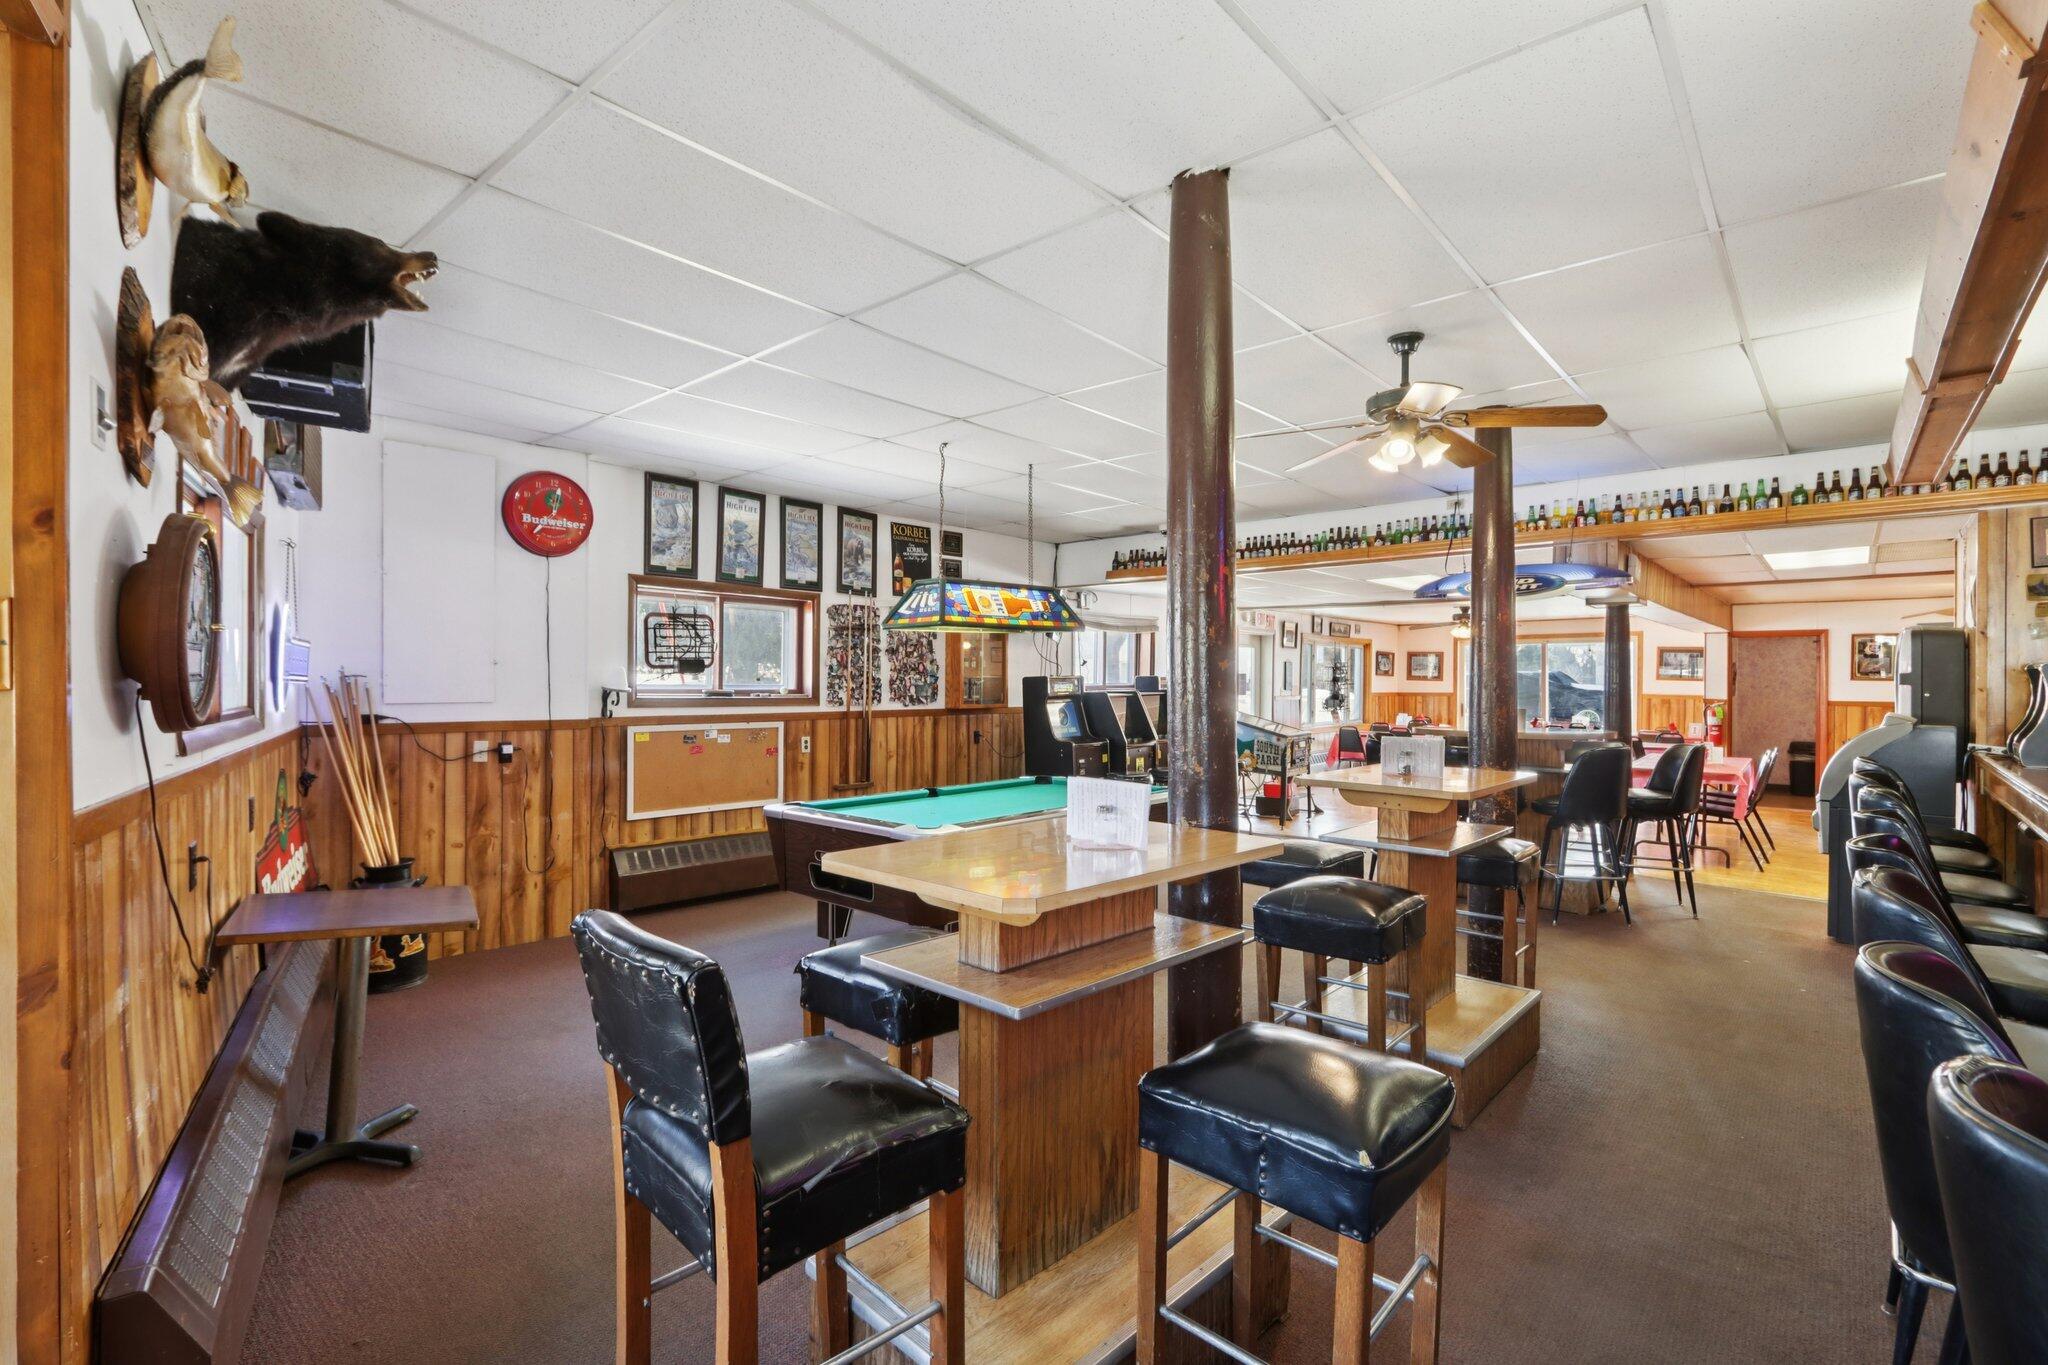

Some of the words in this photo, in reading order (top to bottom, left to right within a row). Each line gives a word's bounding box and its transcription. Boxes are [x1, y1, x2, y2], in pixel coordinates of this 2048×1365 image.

[726, 501, 743, 512] HIGH
[744, 503, 758, 514] LIFE
[521, 513, 586, 530] Budweiser
[804, 513, 816, 522] LIFE
[844, 520, 859, 530] HIGH
[860, 523, 871, 532] LIFE
[893, 524, 929, 539] KORBEL
[897, 591, 938, 615] Lite
[1256, 740, 1280, 756] SOUTH
[1256, 753, 1280, 766] PARK
